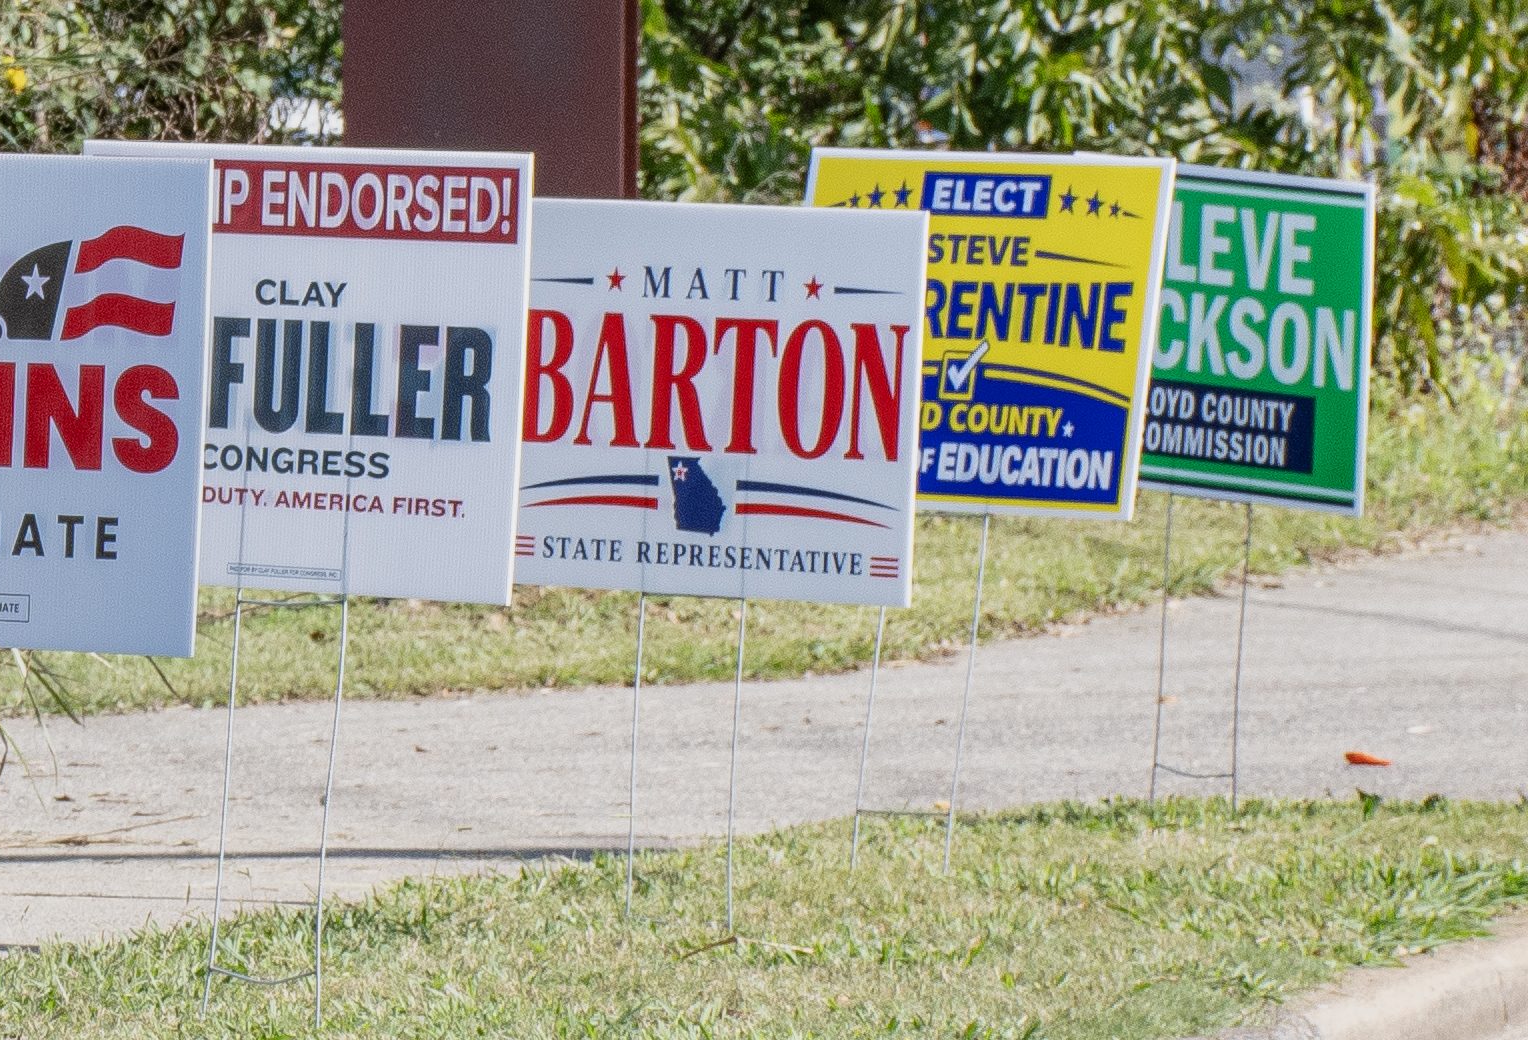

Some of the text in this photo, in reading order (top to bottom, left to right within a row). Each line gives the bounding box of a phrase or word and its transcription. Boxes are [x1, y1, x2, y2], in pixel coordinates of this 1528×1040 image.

[261, 168, 512, 235] ENDORSED!
[931, 178, 1042, 213] ELECT
[928, 233, 1031, 267] STEVE
[1166, 200, 1317, 296] LEVE
[255, 279, 348, 307] CLAY
[642, 265, 785, 302] MATT
[926, 277, 1134, 354] RENTINE
[1152, 287, 1356, 392] CKSON
[209, 316, 494, 443] FULLER
[522, 309, 910, 461] BARTON
[948, 403, 1064, 438] COUNTY
[1146, 386, 1296, 433] OYD COUNTY
[203, 443, 390, 479] CONGRESS
[936, 441, 1113, 491] EDUCATION
[202, 486, 465, 519] DUTY. AMERICA FIRST.
[542, 536, 863, 576] STATE REPRESENTATIVE
